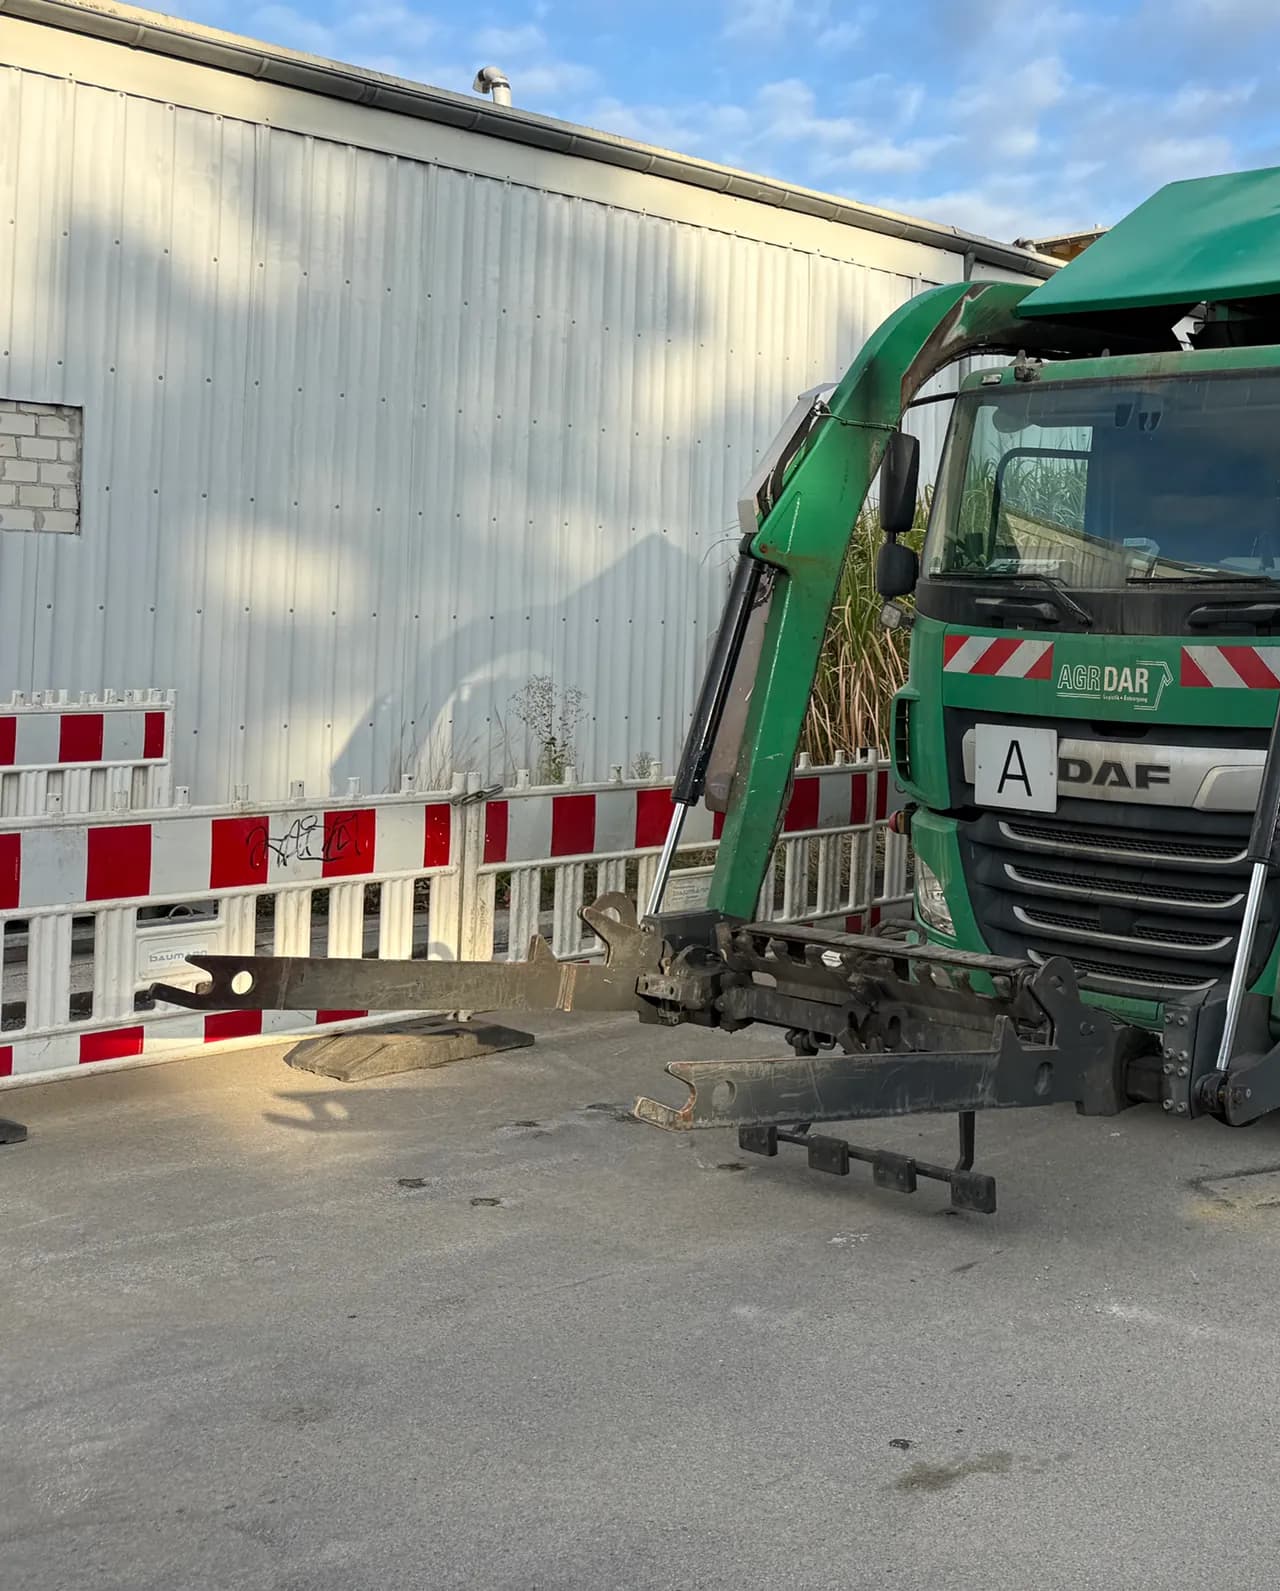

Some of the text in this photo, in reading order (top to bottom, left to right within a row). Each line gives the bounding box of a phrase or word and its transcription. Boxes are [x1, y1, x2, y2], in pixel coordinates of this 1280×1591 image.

[1057, 664, 1149, 694] AGR DAR
[997, 739, 1033, 797] A
[1058, 757, 1171, 790] DAF
